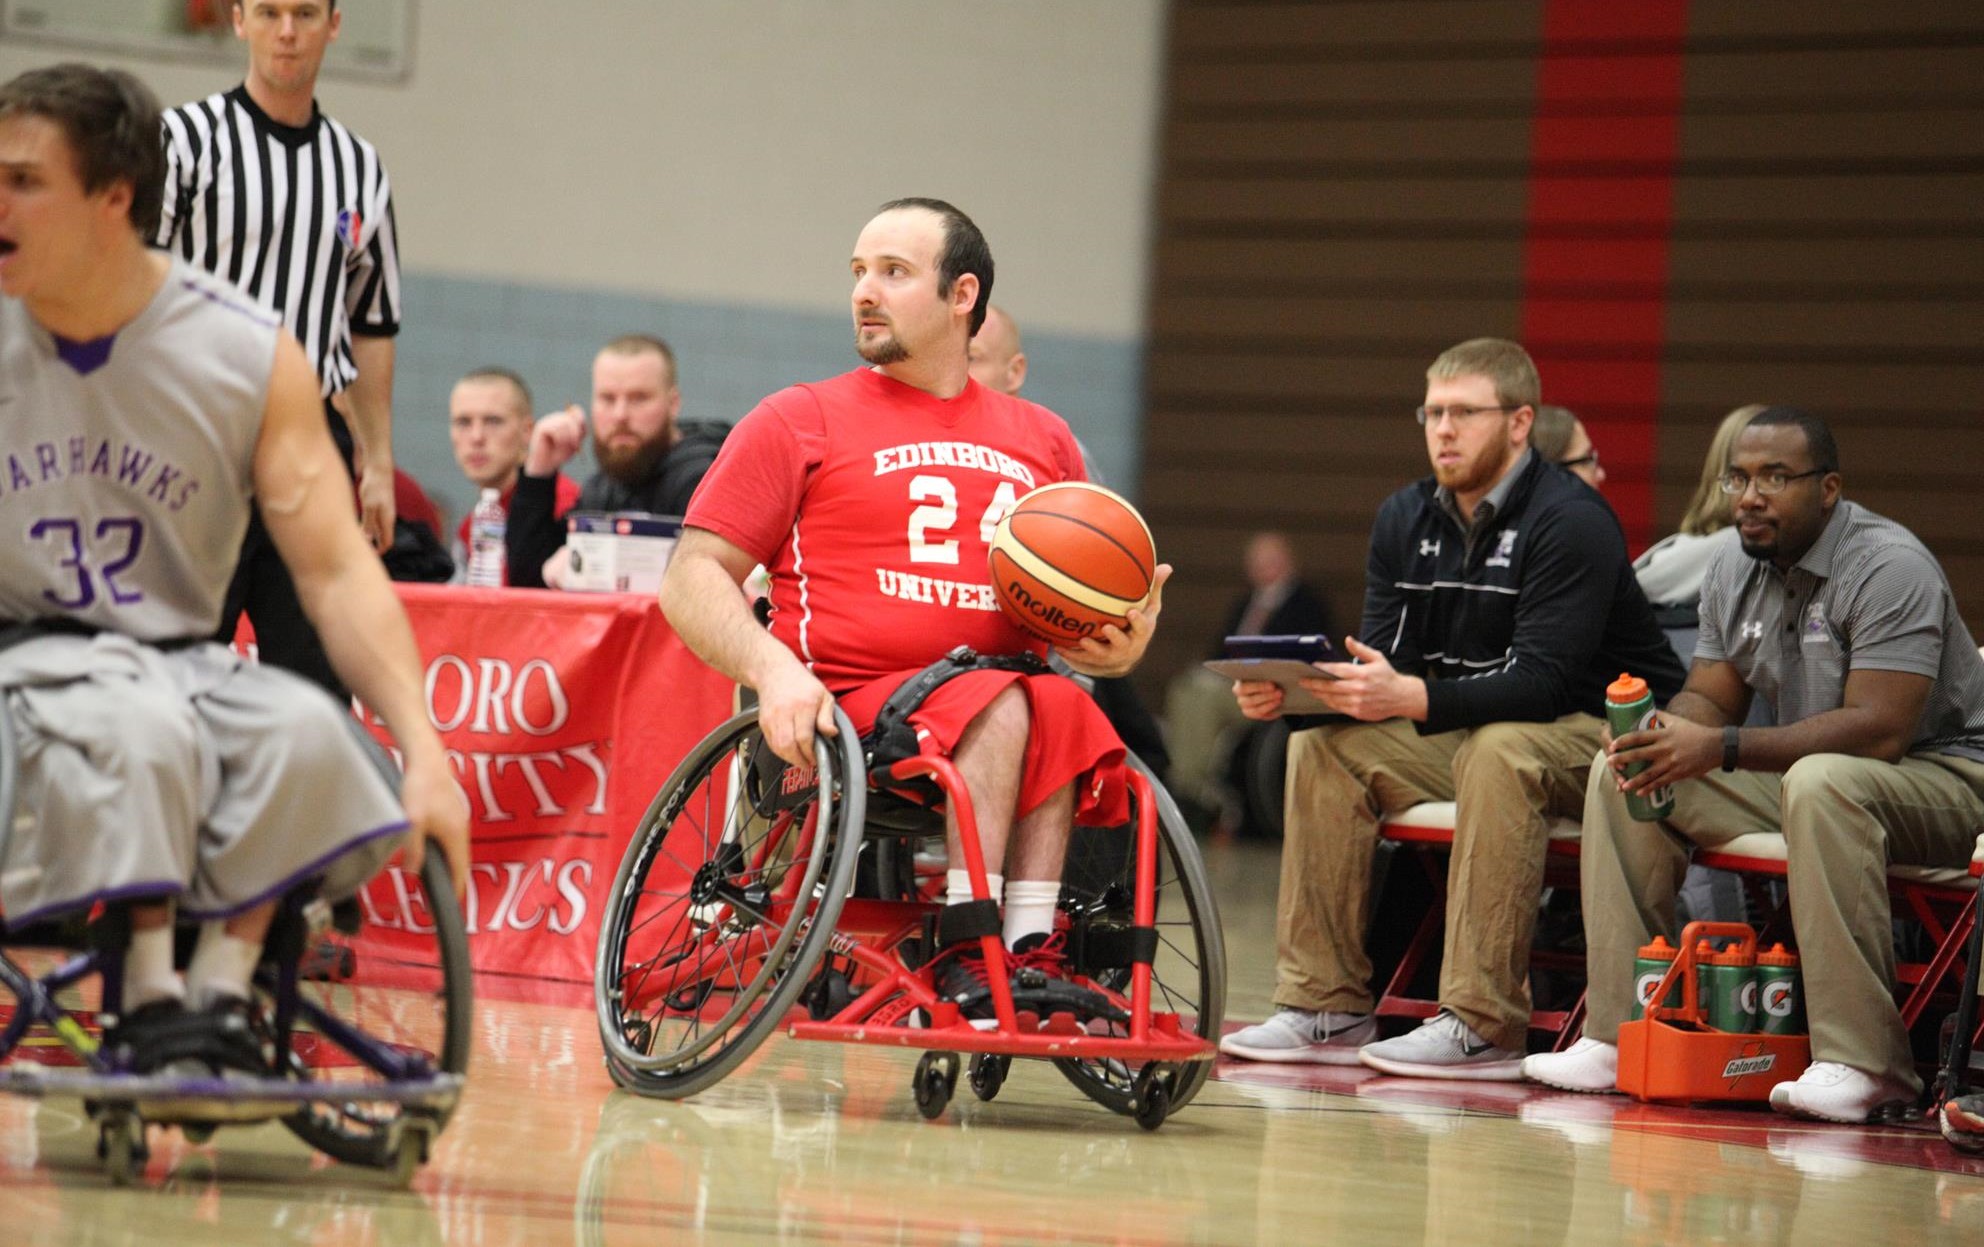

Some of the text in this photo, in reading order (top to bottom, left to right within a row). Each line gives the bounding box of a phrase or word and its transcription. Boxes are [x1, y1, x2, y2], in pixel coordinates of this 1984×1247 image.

[0, 434, 199, 512] ARHAWKS
[873, 441, 1036, 490] EDINBORO
[29, 516, 144, 609] 32
[1008, 581, 1096, 637] molten
[1762, 981, 1793, 1017] G
[1725, 1056, 1772, 1076] Gatorade
